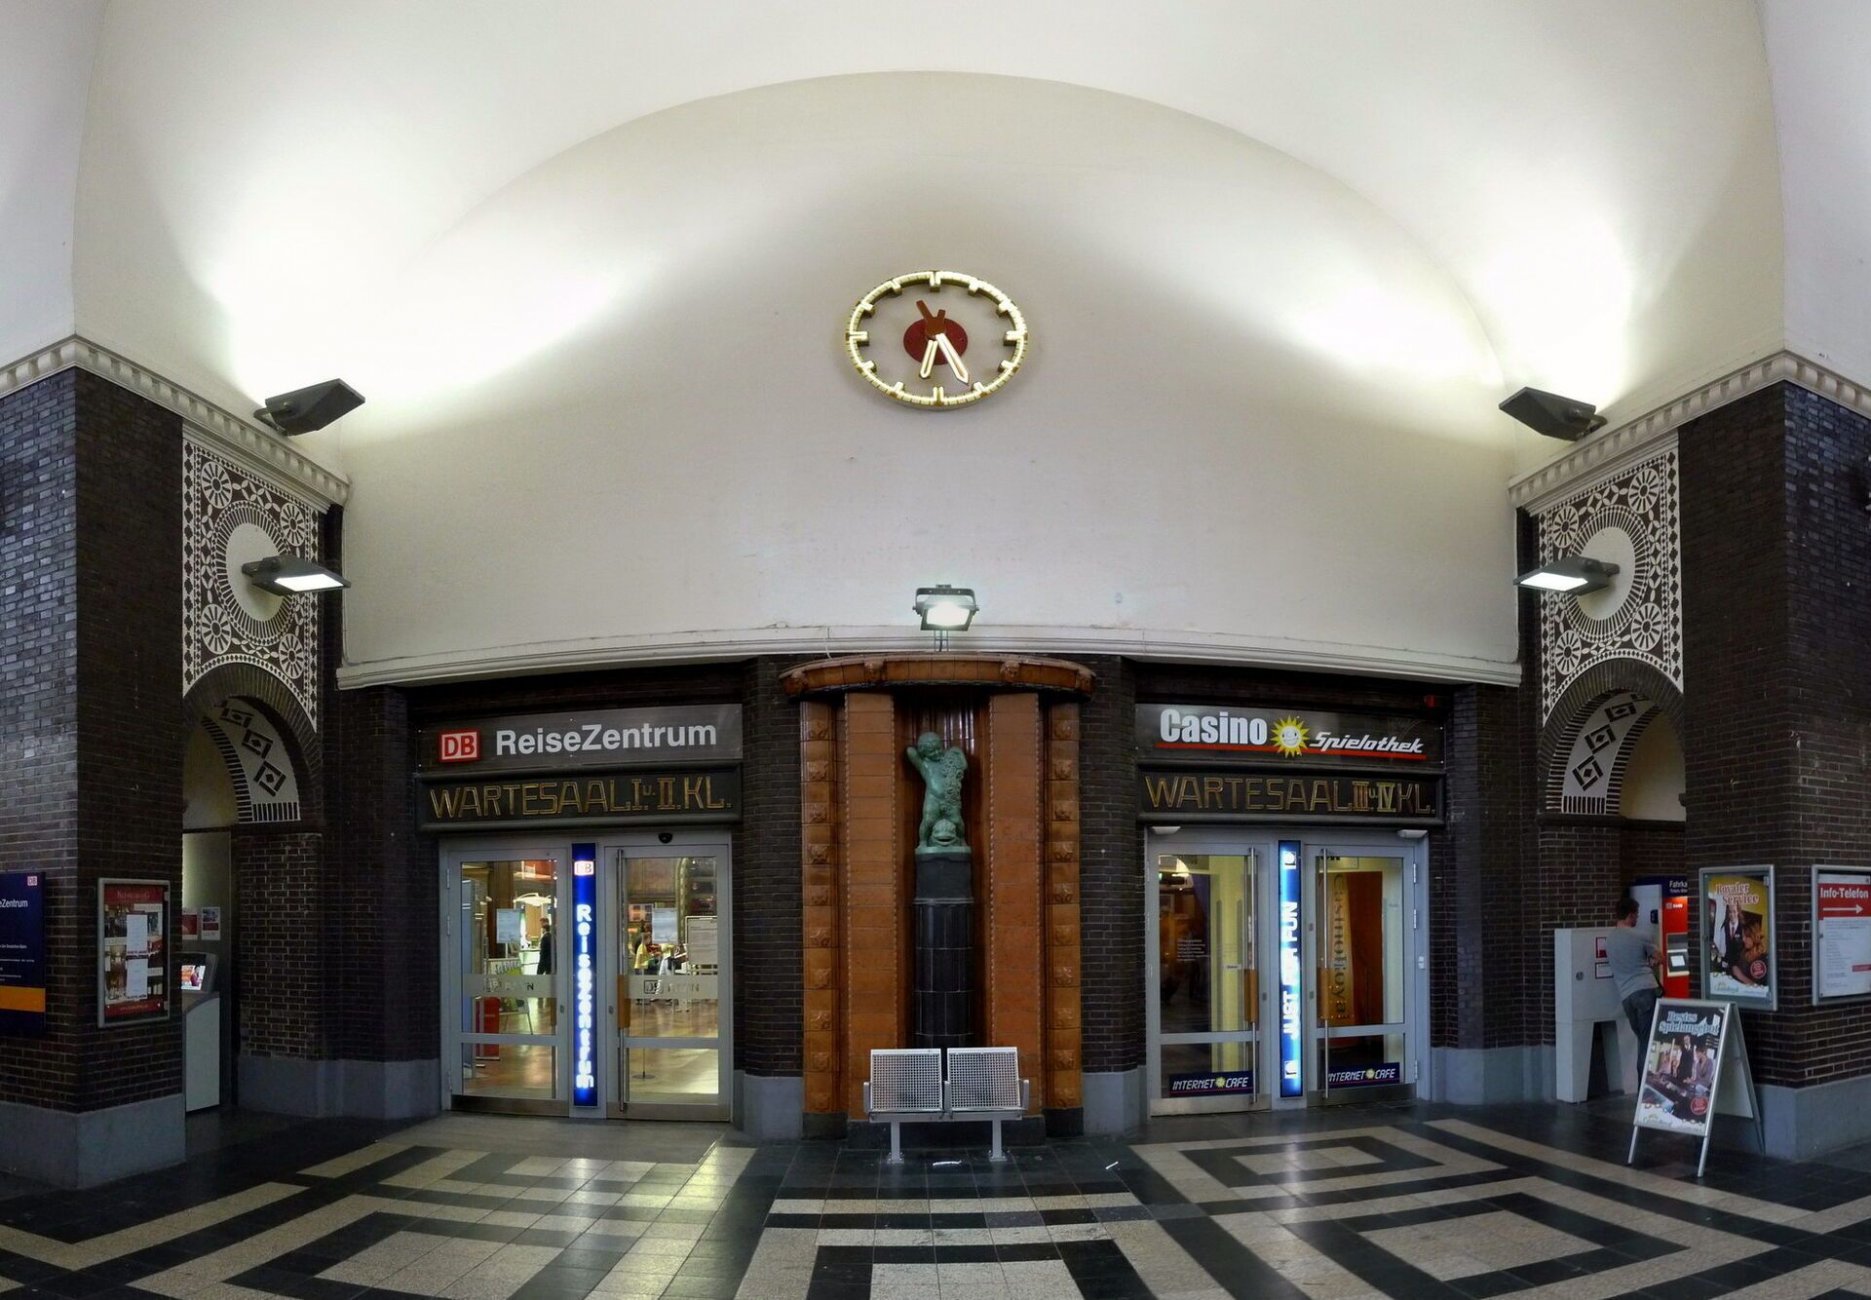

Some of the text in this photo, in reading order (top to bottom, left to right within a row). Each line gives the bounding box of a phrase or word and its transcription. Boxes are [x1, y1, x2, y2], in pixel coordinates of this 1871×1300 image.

[496, 723, 717, 755] ReiseZentrum
[1160, 708, 1267, 745] Casino
[443, 734, 477, 760] DB
[1309, 731, 1424, 755] Spielothek
[429, 779, 631, 818] WARTESAAL
[1145, 776, 1352, 812] WARTESAAL
[1820, 887, 1869, 899] Info-Telefon
[1281, 901, 1298, 941] FUN
[1283, 991, 1299, 1041] JUST
[1172, 1077, 1249, 1090] INTERNET CAFE
[1374, 1068, 1396, 1079] CAFE
